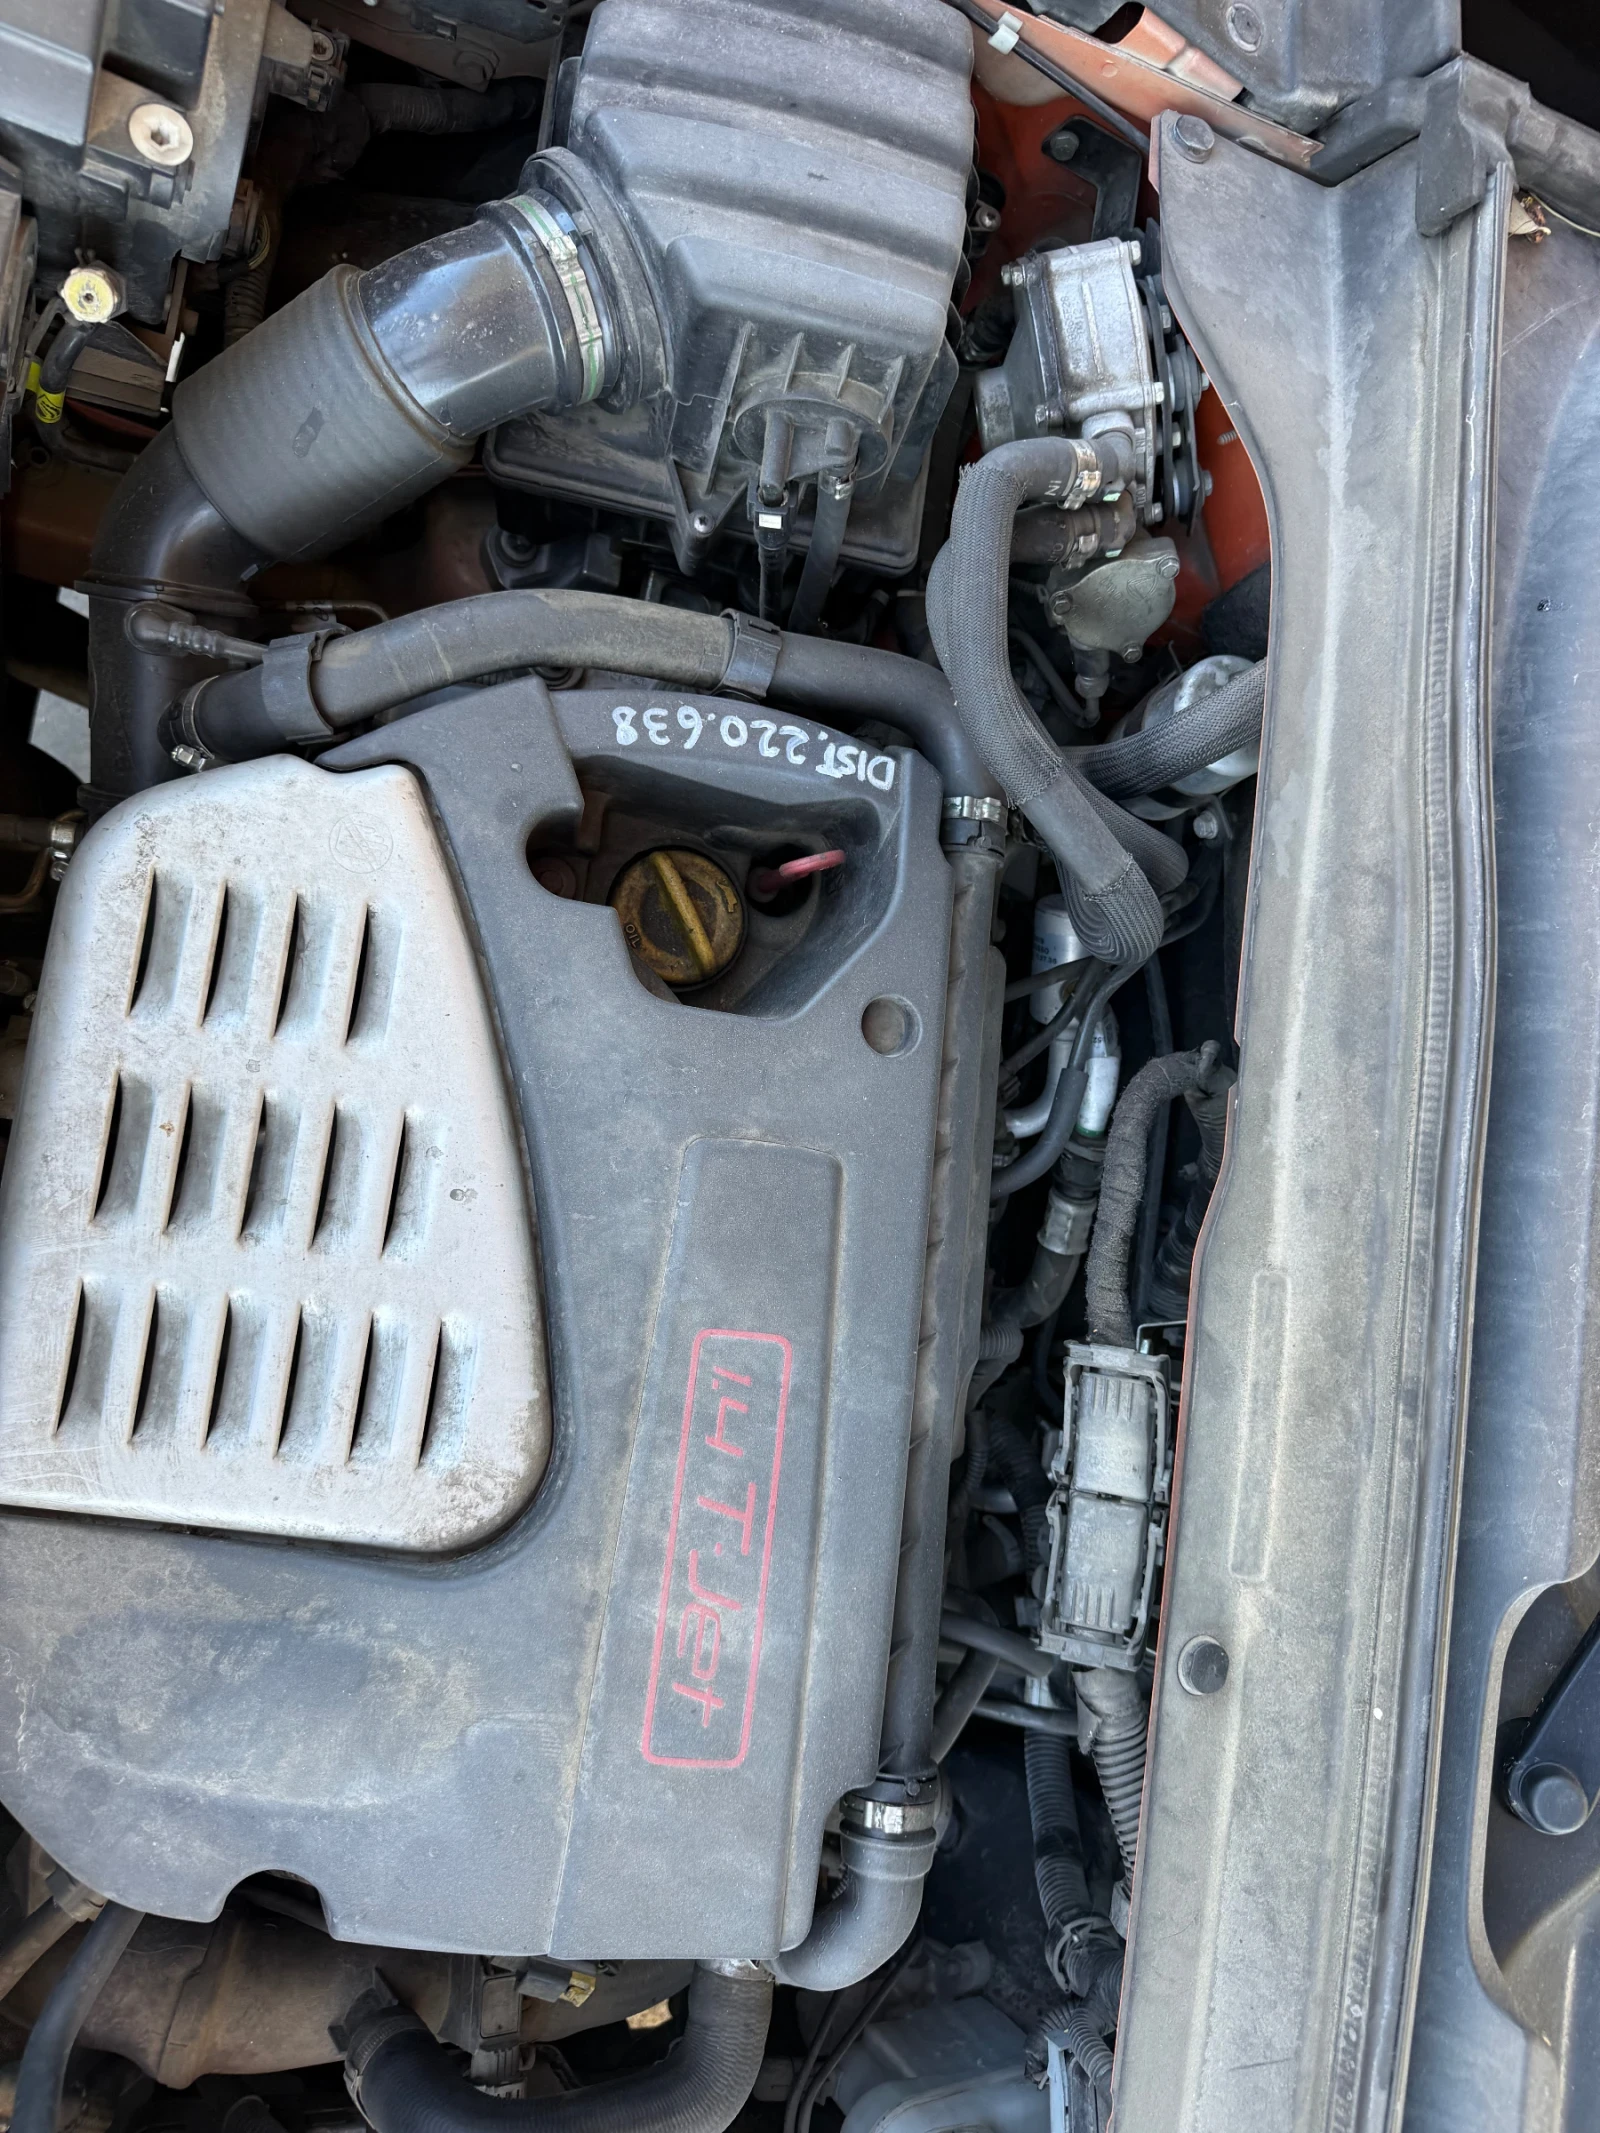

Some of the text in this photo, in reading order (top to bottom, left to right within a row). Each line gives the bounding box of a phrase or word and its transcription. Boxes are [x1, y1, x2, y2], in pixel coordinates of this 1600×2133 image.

[1044, 480, 1062, 496] IN
[625, 924, 640, 948] OIL
[705, 1365, 752, 1458] 1.4
